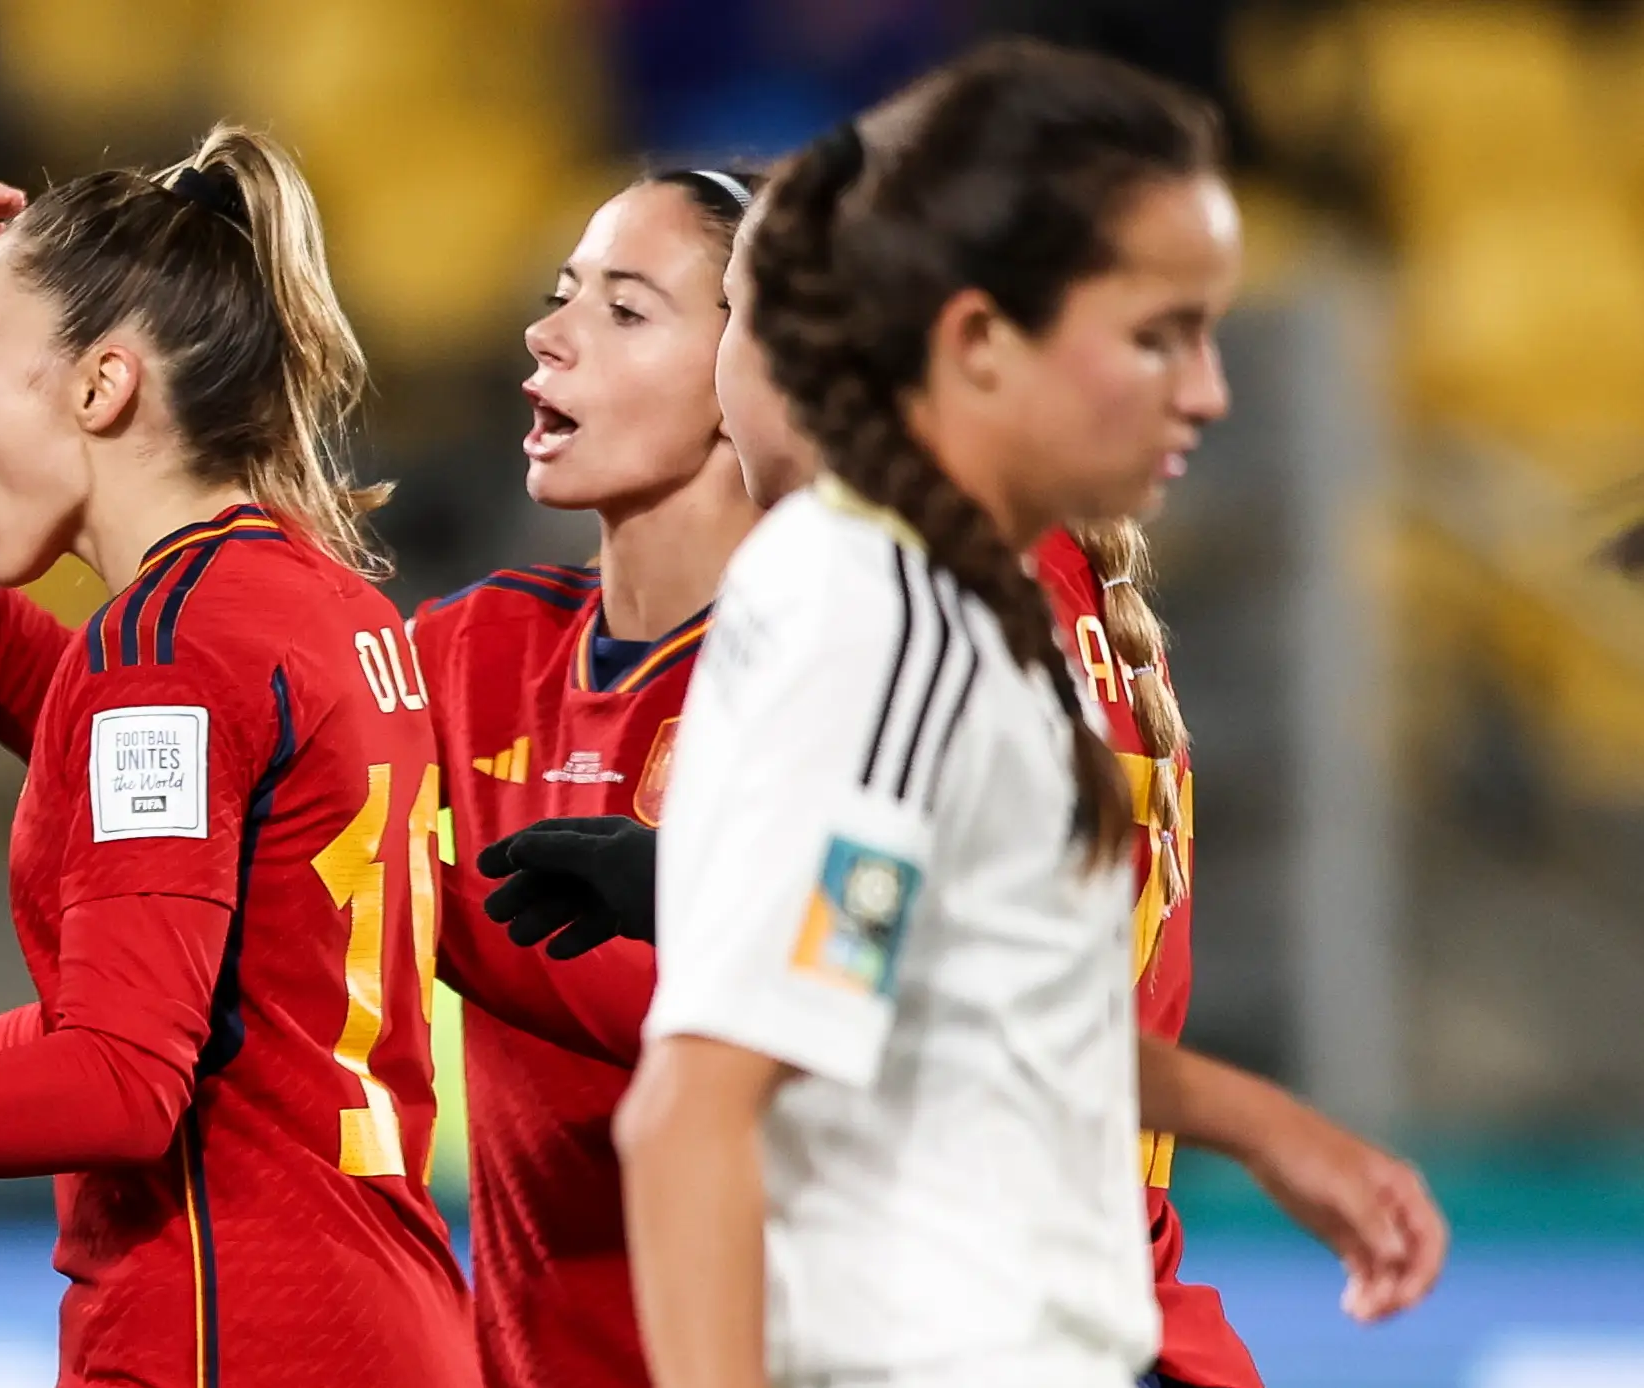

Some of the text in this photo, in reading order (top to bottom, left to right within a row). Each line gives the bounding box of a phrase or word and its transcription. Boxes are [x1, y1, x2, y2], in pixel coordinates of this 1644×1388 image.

[115, 730, 181, 747] FOOTBALL
[116, 748, 180, 771] UNITES
[112, 771, 185, 793] the World
